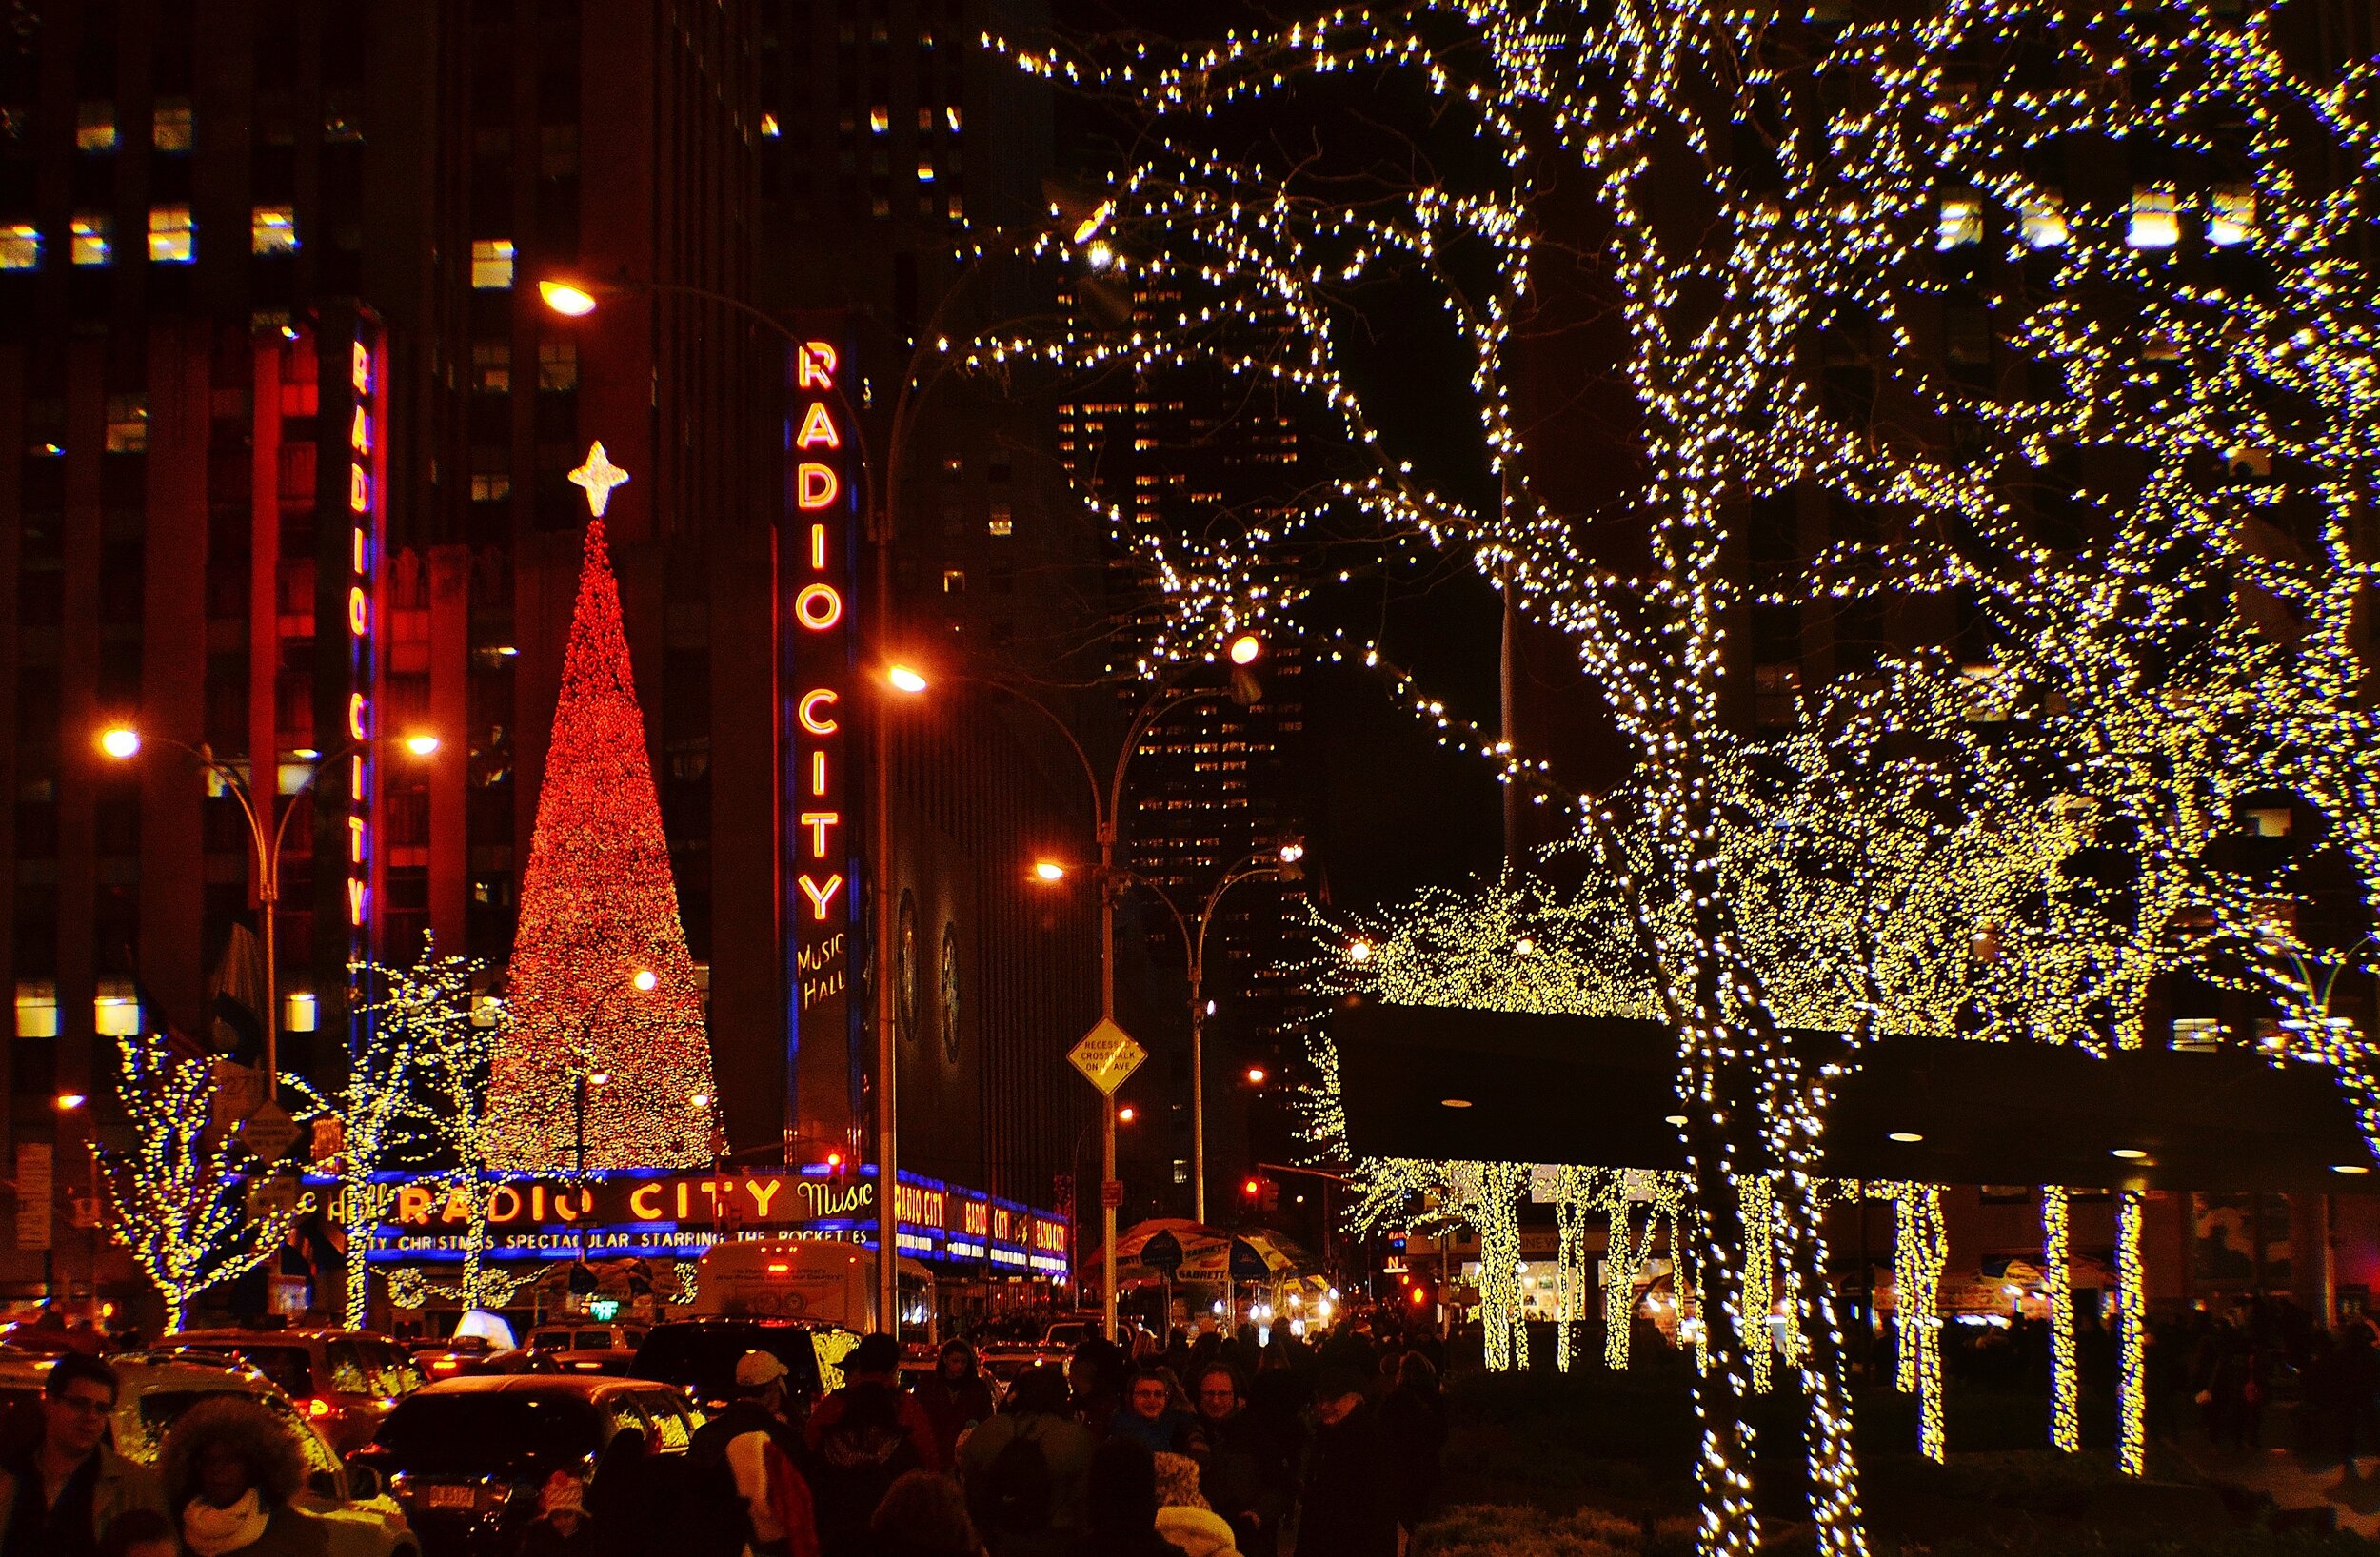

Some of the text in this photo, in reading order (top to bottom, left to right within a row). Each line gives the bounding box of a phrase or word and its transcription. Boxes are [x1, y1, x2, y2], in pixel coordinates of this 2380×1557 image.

[348, 341, 368, 926] RADIO CITY
[796, 341, 843, 920] RADIO CITY
[798, 933, 844, 978] MUSIC
[804, 970, 845, 1010] HALL
[1081, 1051, 1135, 1060] CROSSALK
[1085, 1062, 1130, 1071] ON AVE
[399, 1186, 592, 1224] RADIO
[630, 1179, 781, 1220] CITY
[797, 1181, 873, 1218] Music
[894, 1184, 943, 1228] RADIO CITY
[965, 1202, 987, 1236] RADIO
[994, 1208, 1009, 1240] CITY
[641, 1232, 724, 1248] STARRING
[736, 1231, 765, 1242] THE
[1179, 1270, 1225, 1280] SABRETT
